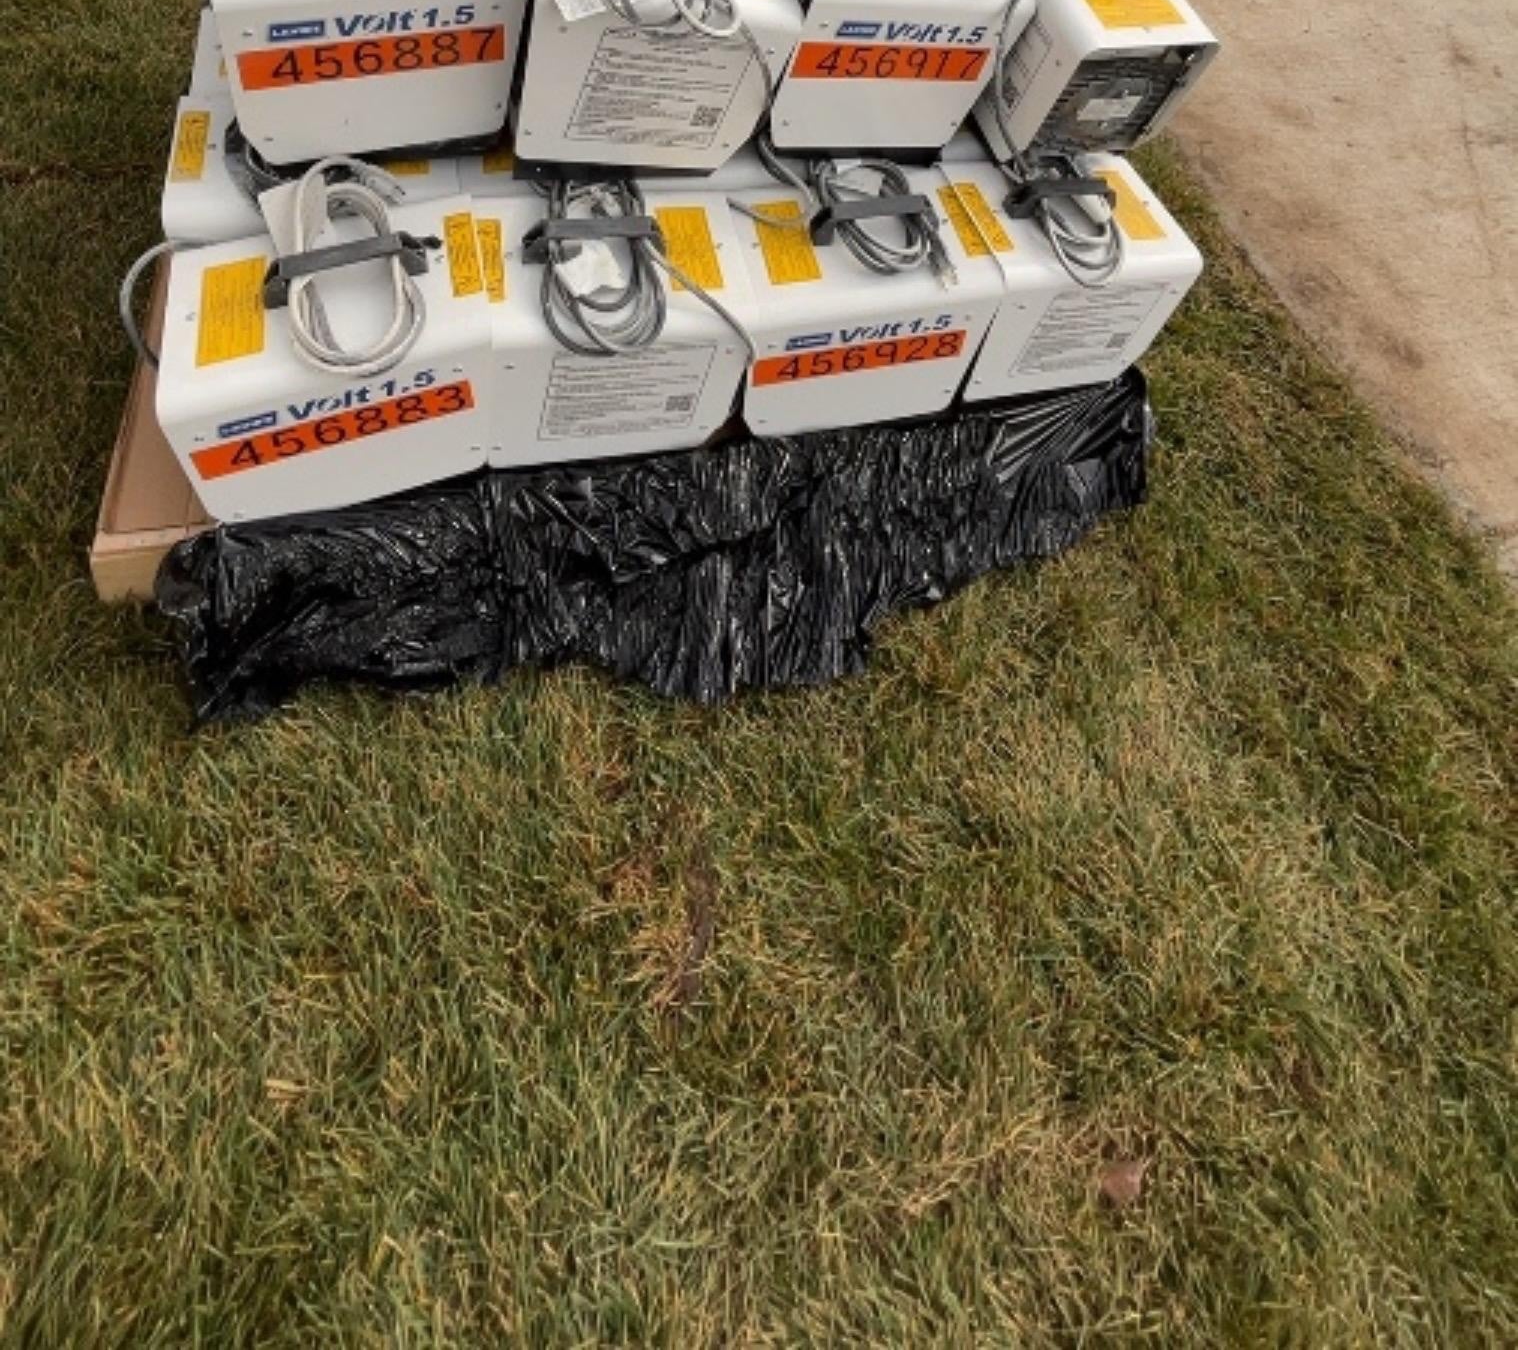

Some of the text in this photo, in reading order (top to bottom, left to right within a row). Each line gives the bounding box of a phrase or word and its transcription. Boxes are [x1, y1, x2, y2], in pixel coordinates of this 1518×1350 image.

[334, 9, 416, 37] Volt
[423, 5, 475, 28] 1.5
[885, 22, 943, 42] Volt
[947, 26, 988, 44] 1.5
[271, 28, 496, 83] 456887
[815, 46, 986, 78] 456917
[839, 322, 902, 342] Volt
[907, 314, 953, 333] 1.5
[777, 332, 960, 379] 456928
[287, 369, 436, 420] Volt 1.5
[230, 385, 466, 466] 456883
